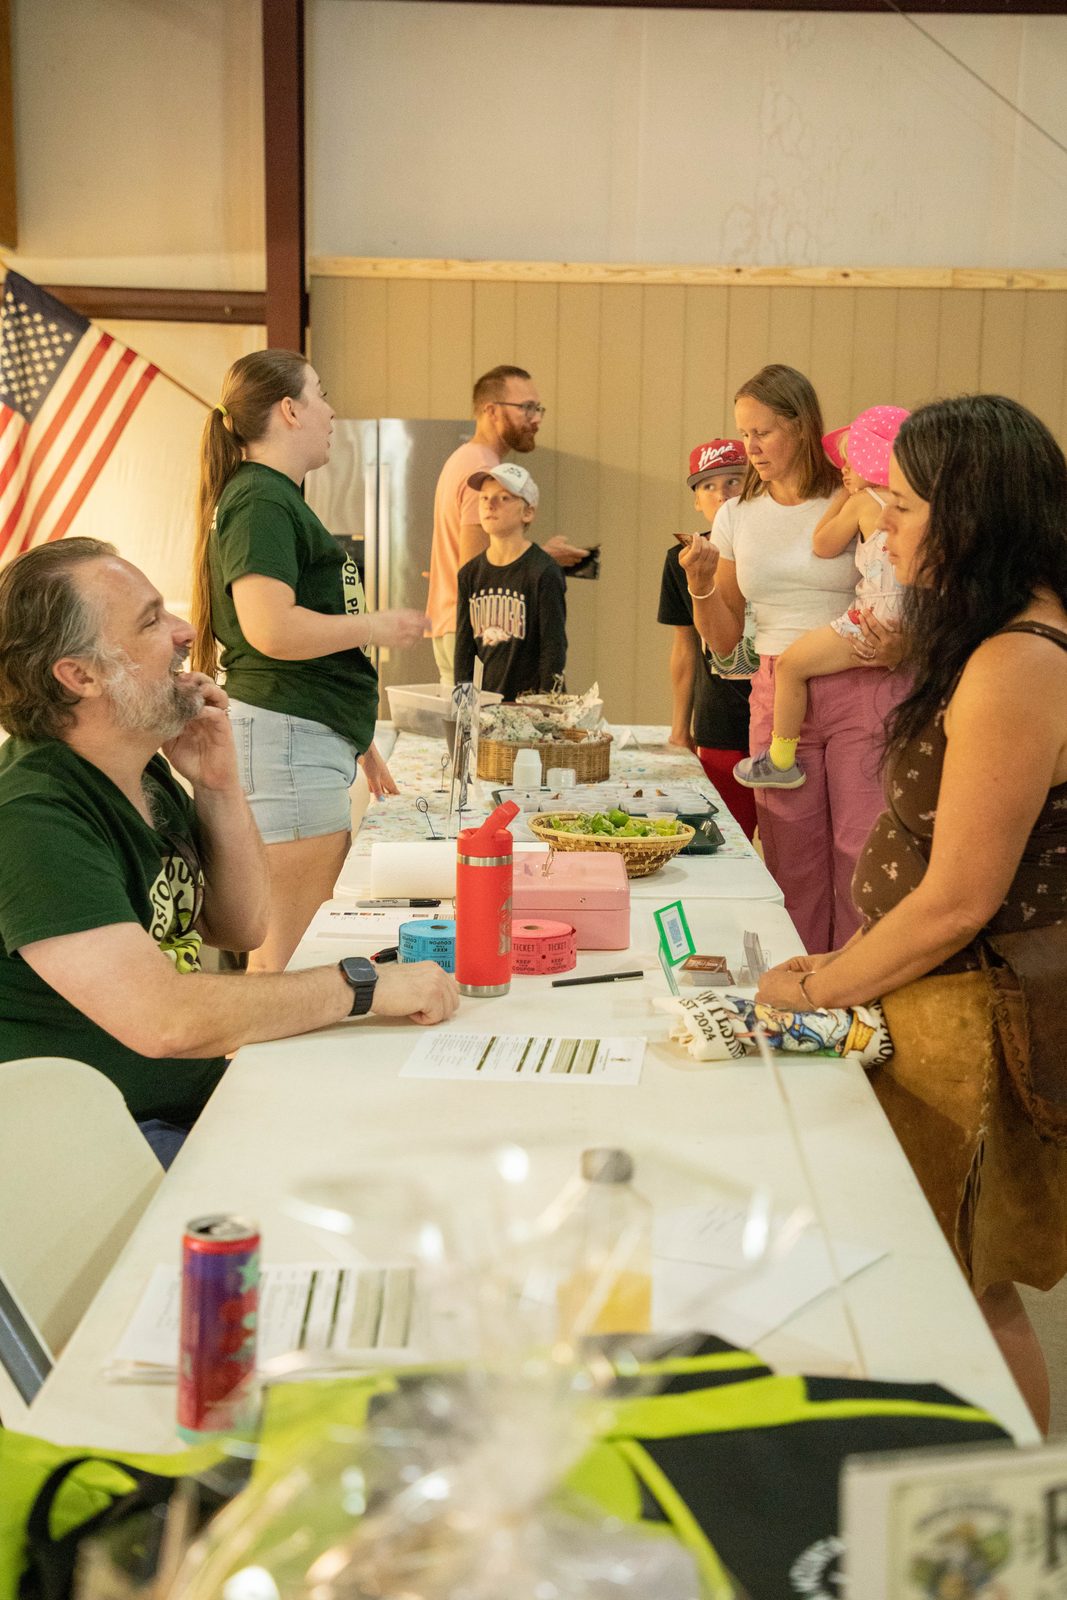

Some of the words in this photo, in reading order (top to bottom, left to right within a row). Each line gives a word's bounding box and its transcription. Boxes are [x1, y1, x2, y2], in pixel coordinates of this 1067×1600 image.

[513, 943, 535, 952] TICKET
[548, 941, 567, 951] TICKET
[693, 1011, 717, 1042] 2024
